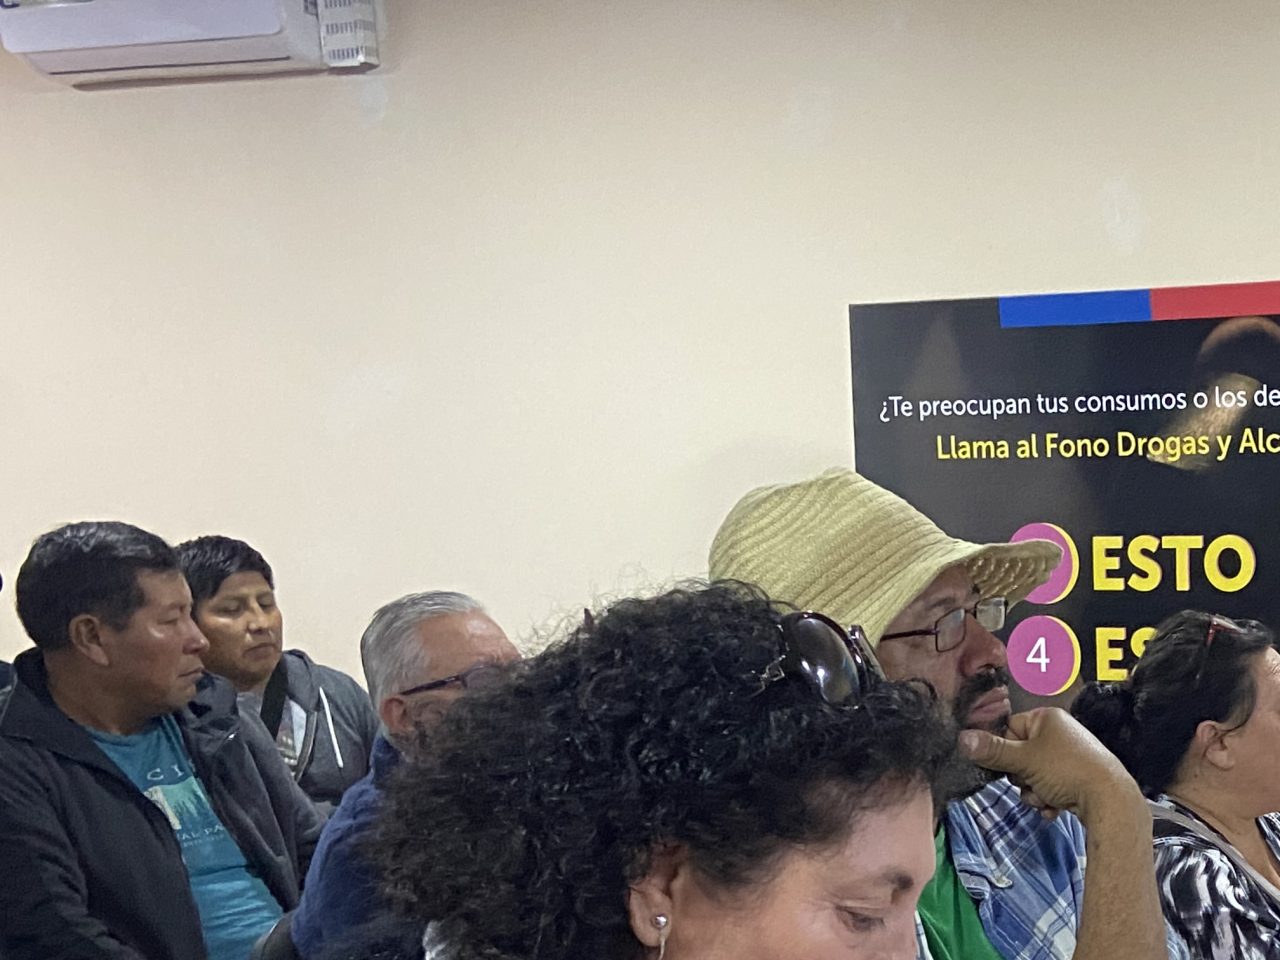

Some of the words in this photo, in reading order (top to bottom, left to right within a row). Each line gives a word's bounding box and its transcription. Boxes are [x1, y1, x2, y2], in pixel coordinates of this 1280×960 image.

[879, 395, 913, 422] ¿Te
[919, 396, 1031, 421] preocupan
[1036, 393, 1069, 413] tus
[1073, 391, 1187, 413] consumos
[1192, 391, 1209, 406] o
[1214, 385, 1248, 408] los
[936, 435, 1010, 460] Llama
[1015, 433, 1039, 459] al
[1045, 432, 1110, 458] Fono
[1116, 430, 1210, 462] Drogas
[1216, 434, 1232, 461] y
[1092, 534, 1257, 593] ESTO
[1026, 637, 1050, 673] 4
